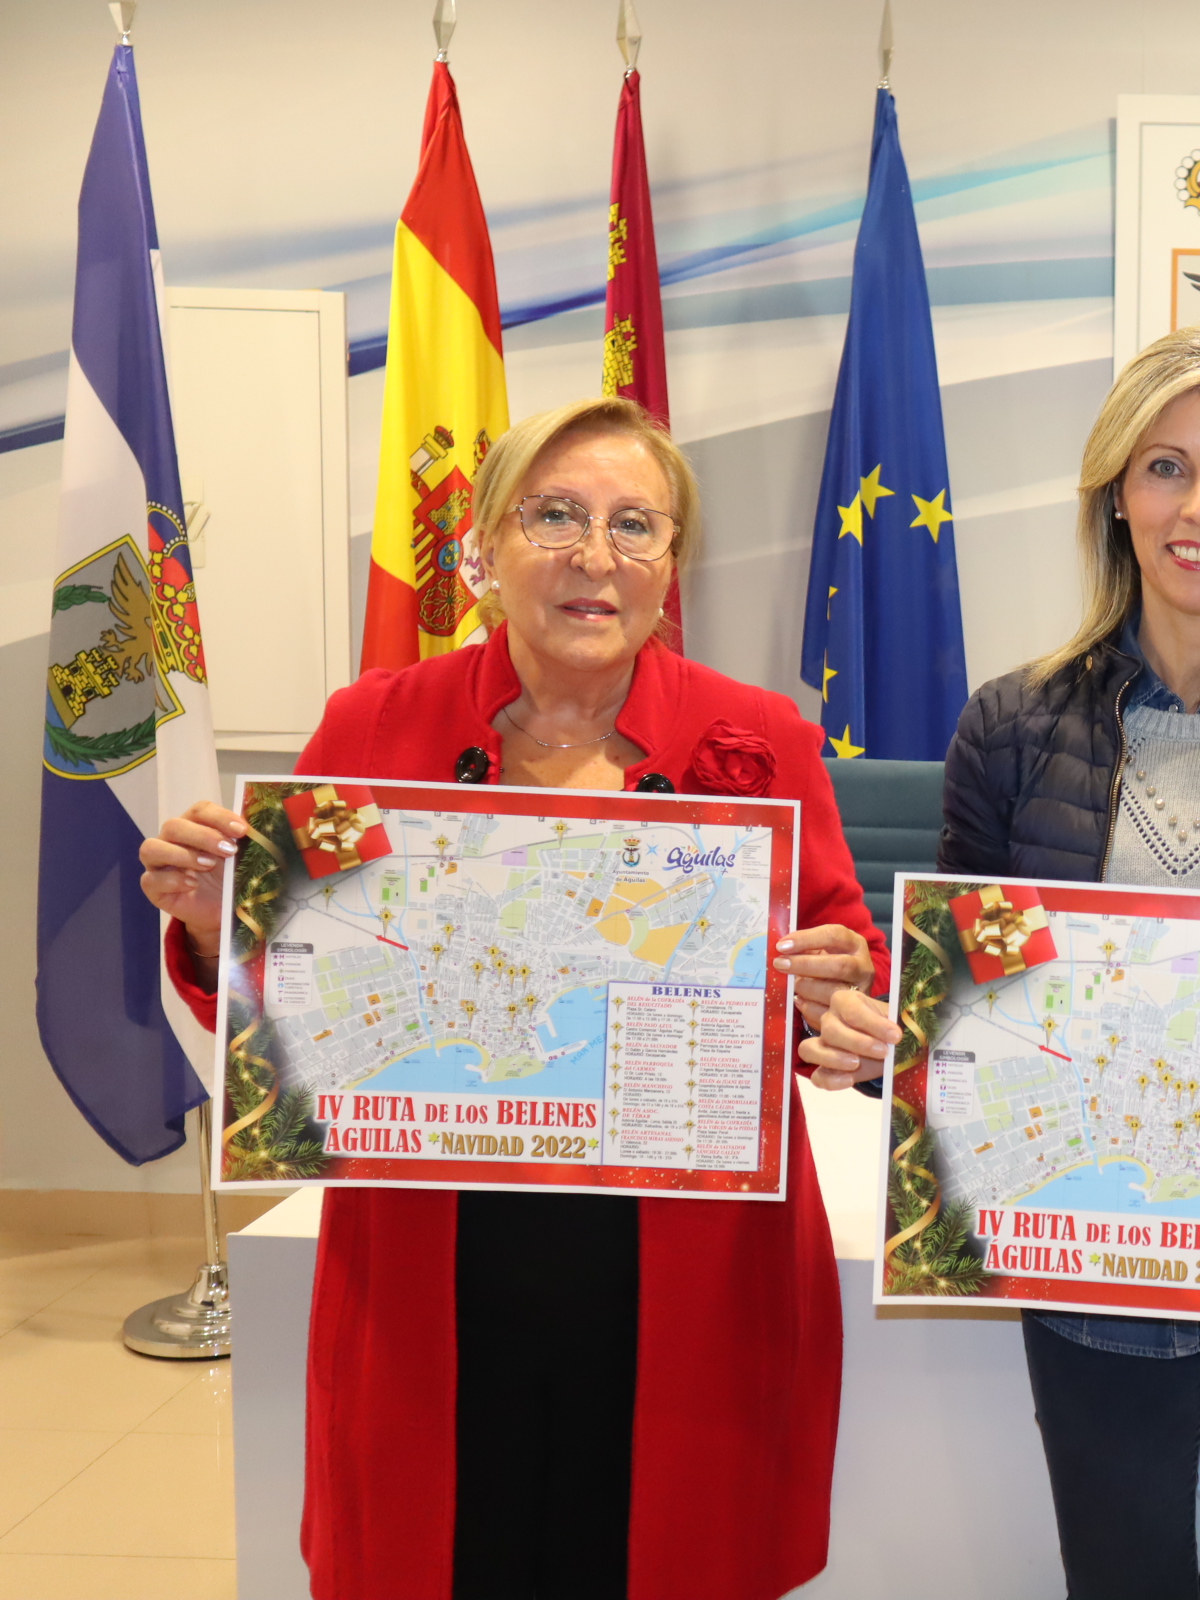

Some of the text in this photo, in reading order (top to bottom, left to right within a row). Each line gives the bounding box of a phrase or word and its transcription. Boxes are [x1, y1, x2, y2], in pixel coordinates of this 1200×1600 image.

[612, 869, 649, 877] Ayuntamiento
[651, 986, 721, 998] BELENES
[317, 1095, 597, 1128] IV RUTA DE LOS BELENES
[325, 1123, 586, 1158] ÁGUILAS NAVIDAD 2022
[978, 1209, 1004, 1236] IV
[1013, 1211, 1076, 1241] RUTA
[1086, 1223, 1110, 1244] DE
[1117, 1225, 1151, 1246] LOS
[985, 1240, 1082, 1274] ÁGUILAS
[1102, 1252, 1188, 1282] NAVIDAD
